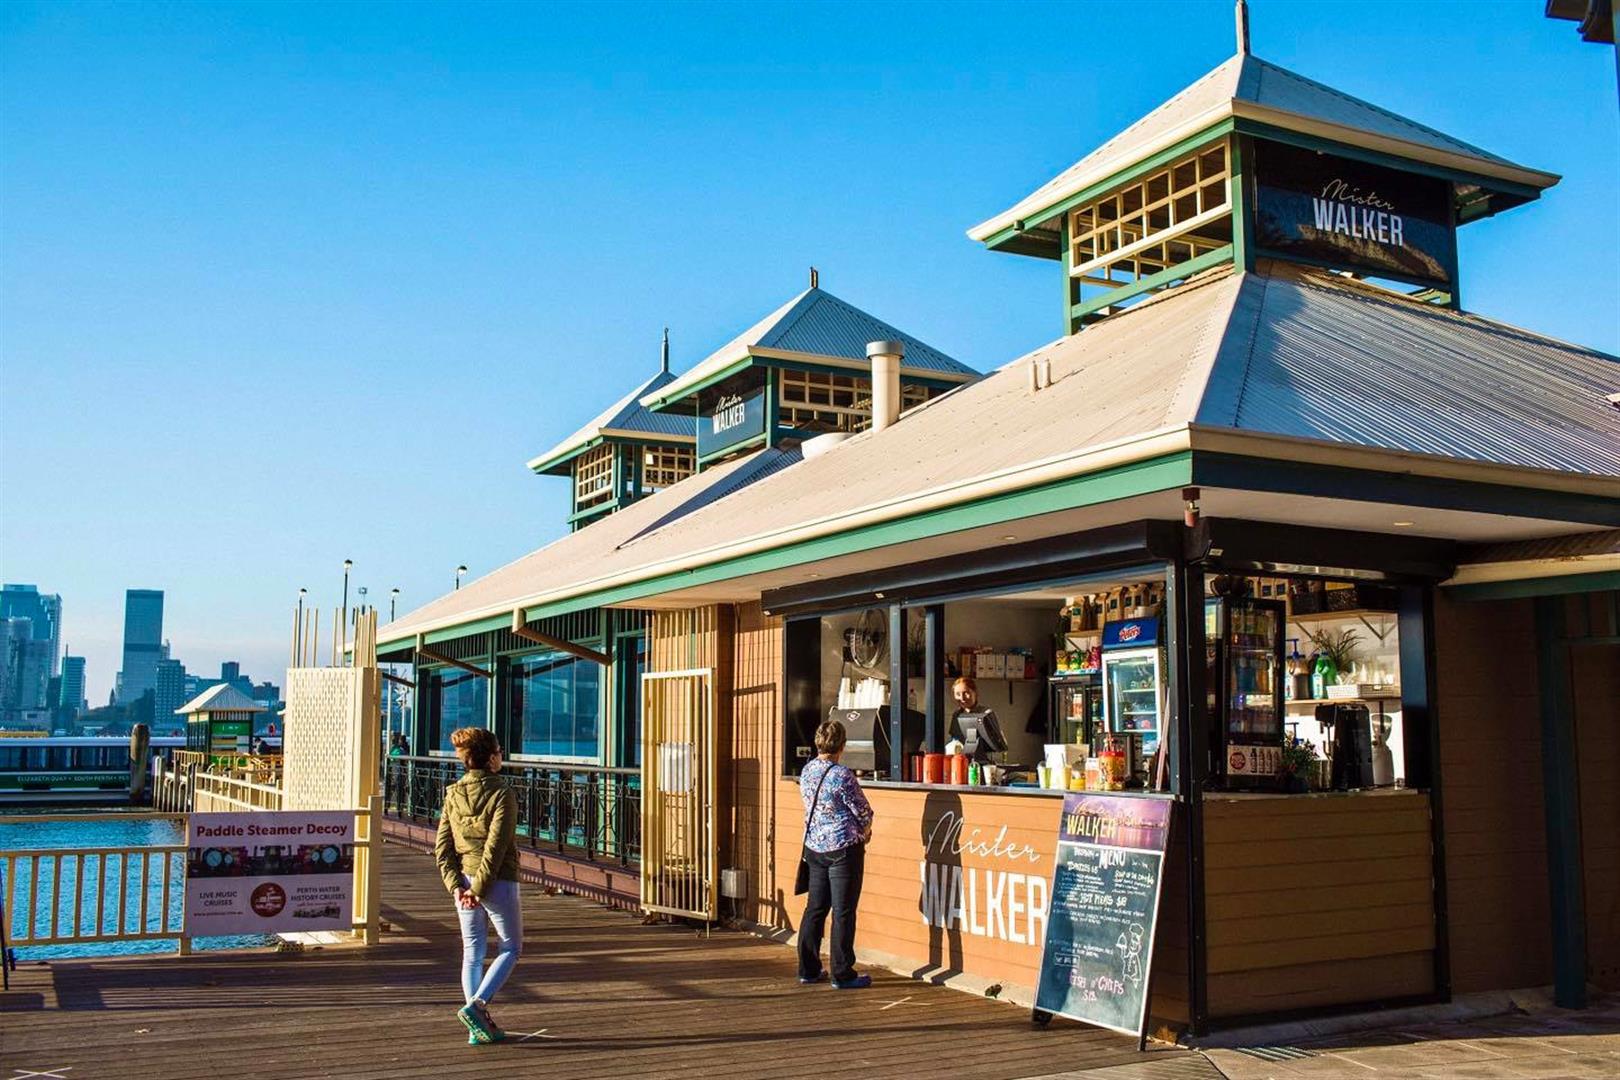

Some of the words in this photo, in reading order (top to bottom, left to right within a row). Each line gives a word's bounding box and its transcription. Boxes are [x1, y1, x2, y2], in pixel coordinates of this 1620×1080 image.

[1321, 178, 1395, 210] Mister
[1313, 197, 1403, 246] WALKER
[712, 402, 745, 434] WALKER
[197, 825, 244, 837] Paddle
[247, 824, 303, 837] Steamer
[306, 823, 348, 836] Decoy
[926, 810, 1041, 863] Mister
[1066, 814, 1117, 838] WALKER
[1099, 849, 1126, 869] MENU
[919, 861, 1048, 946] WALKER
[1098, 975, 1124, 995] CHIPS
